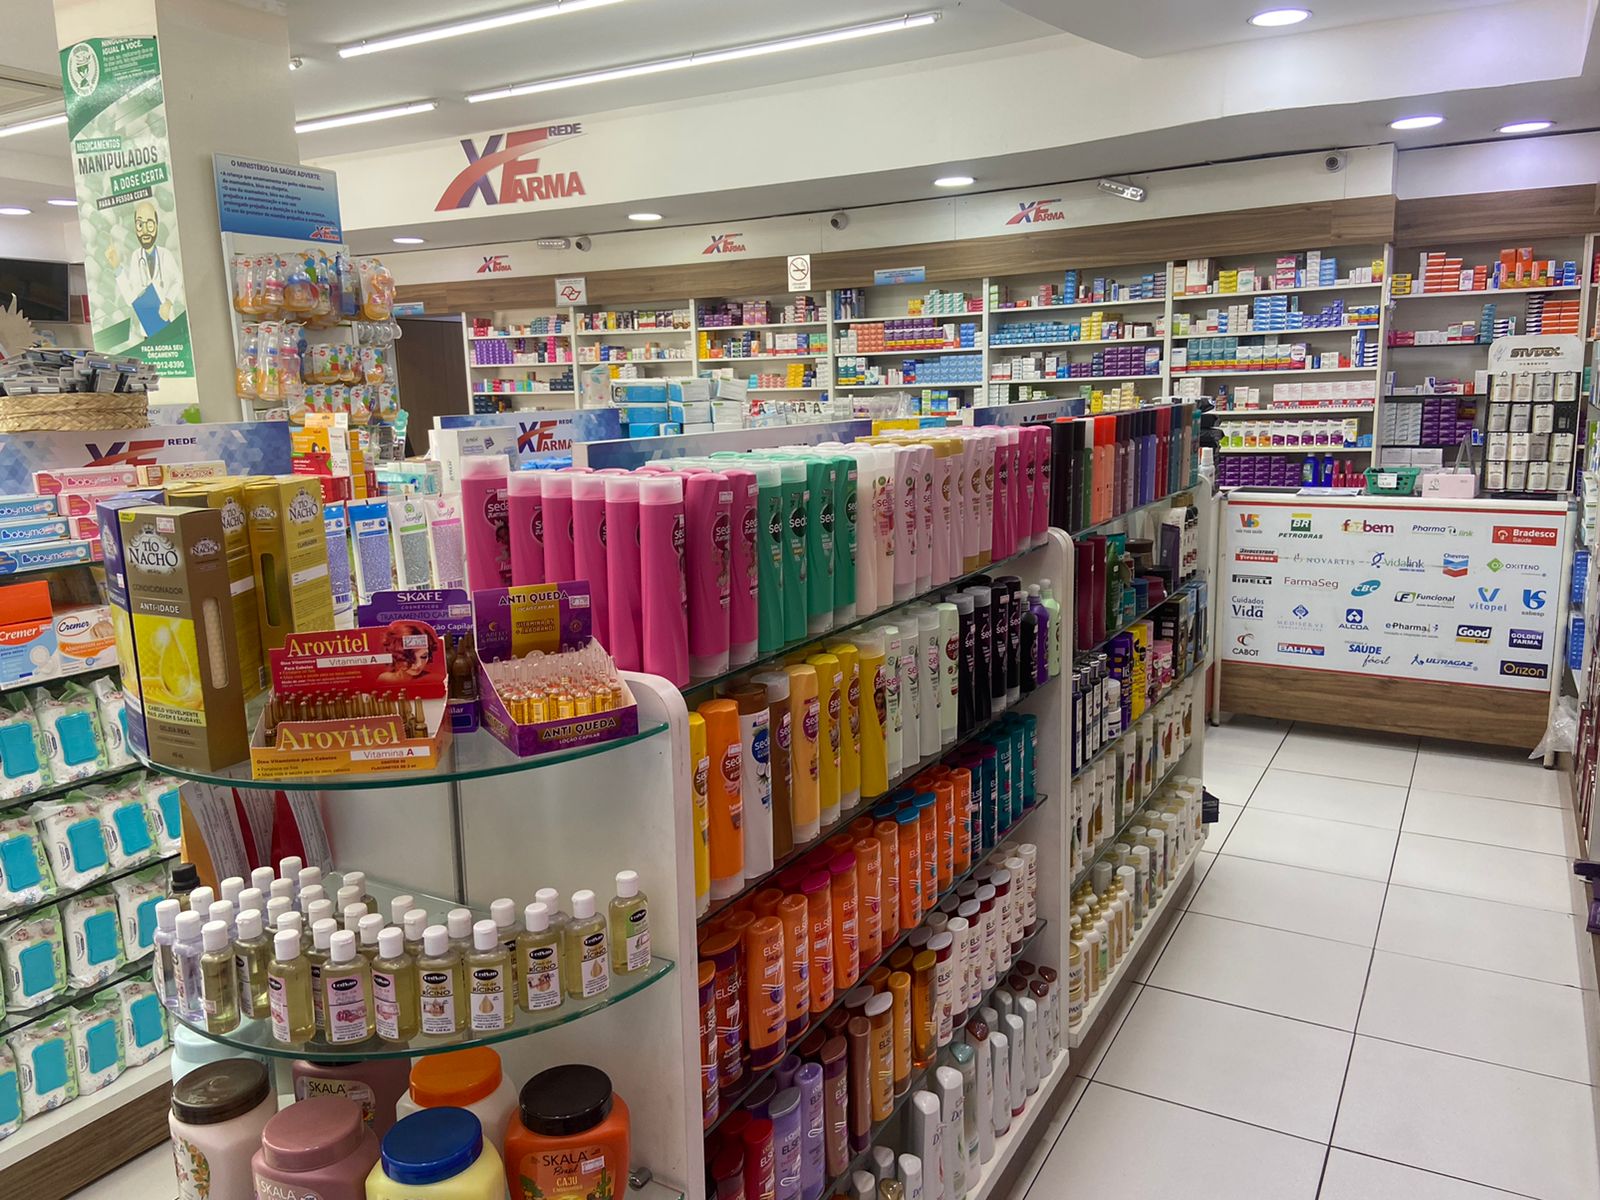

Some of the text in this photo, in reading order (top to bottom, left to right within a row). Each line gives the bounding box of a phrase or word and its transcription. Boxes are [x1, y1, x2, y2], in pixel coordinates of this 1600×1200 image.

[549, 122, 582, 137] REDE
[78, 145, 159, 175] MANIPULADOS
[113, 167, 165, 192] A DOSE CERTA
[168, 437, 197, 446] REDE
[289, 503, 318, 521] NACHO
[1293, 519, 1310, 528] BR
[1412, 525, 1446, 533] Pharma
[1278, 532, 1323, 540] PETROBRAS
[1512, 528, 1556, 538] Bradesco
[129, 548, 178, 568] NACHO
[1306, 556, 1356, 566] NOVARTIS
[1505, 562, 1540, 571] OXITENO
[1232, 574, 1272, 585] PIRELLI
[1284, 576, 1339, 590] FarmaSeg
[397, 592, 443, 602] SKAFE
[499, 593, 526, 606] ANTI
[529, 590, 569, 604] QUEDA
[1232, 595, 1264, 605] Cuidados
[1416, 593, 1456, 602] Funcional
[140, 602, 180, 614] ANTI-IDADE
[1232, 604, 1263, 618] Vida
[1469, 603, 1507, 612] vitopel
[59, 620, 90, 632] Cremer
[1338, 623, 1369, 631] ALCOA
[1458, 626, 1490, 638] Good
[0, 627, 38, 641] Cremer
[1511, 632, 1542, 640] GOLDEN
[287, 633, 369, 657] Arovitel
[1232, 647, 1259, 657] CABOT
[328, 656, 377, 666] Vitamina A
[1426, 657, 1473, 667] ULTRAGAZ
[1503, 662, 1545, 676] Orizon
[543, 717, 616, 738] ANTI QUEDA
[278, 721, 401, 751] Arovitel
[363, 748, 414, 759] Vitamina A
[309, 1080, 346, 1095] SKALA
[542, 1150, 588, 1167] SKALA
[556, 1175, 578, 1187] CAJU
[260, 1181, 296, 1199] SKALA
